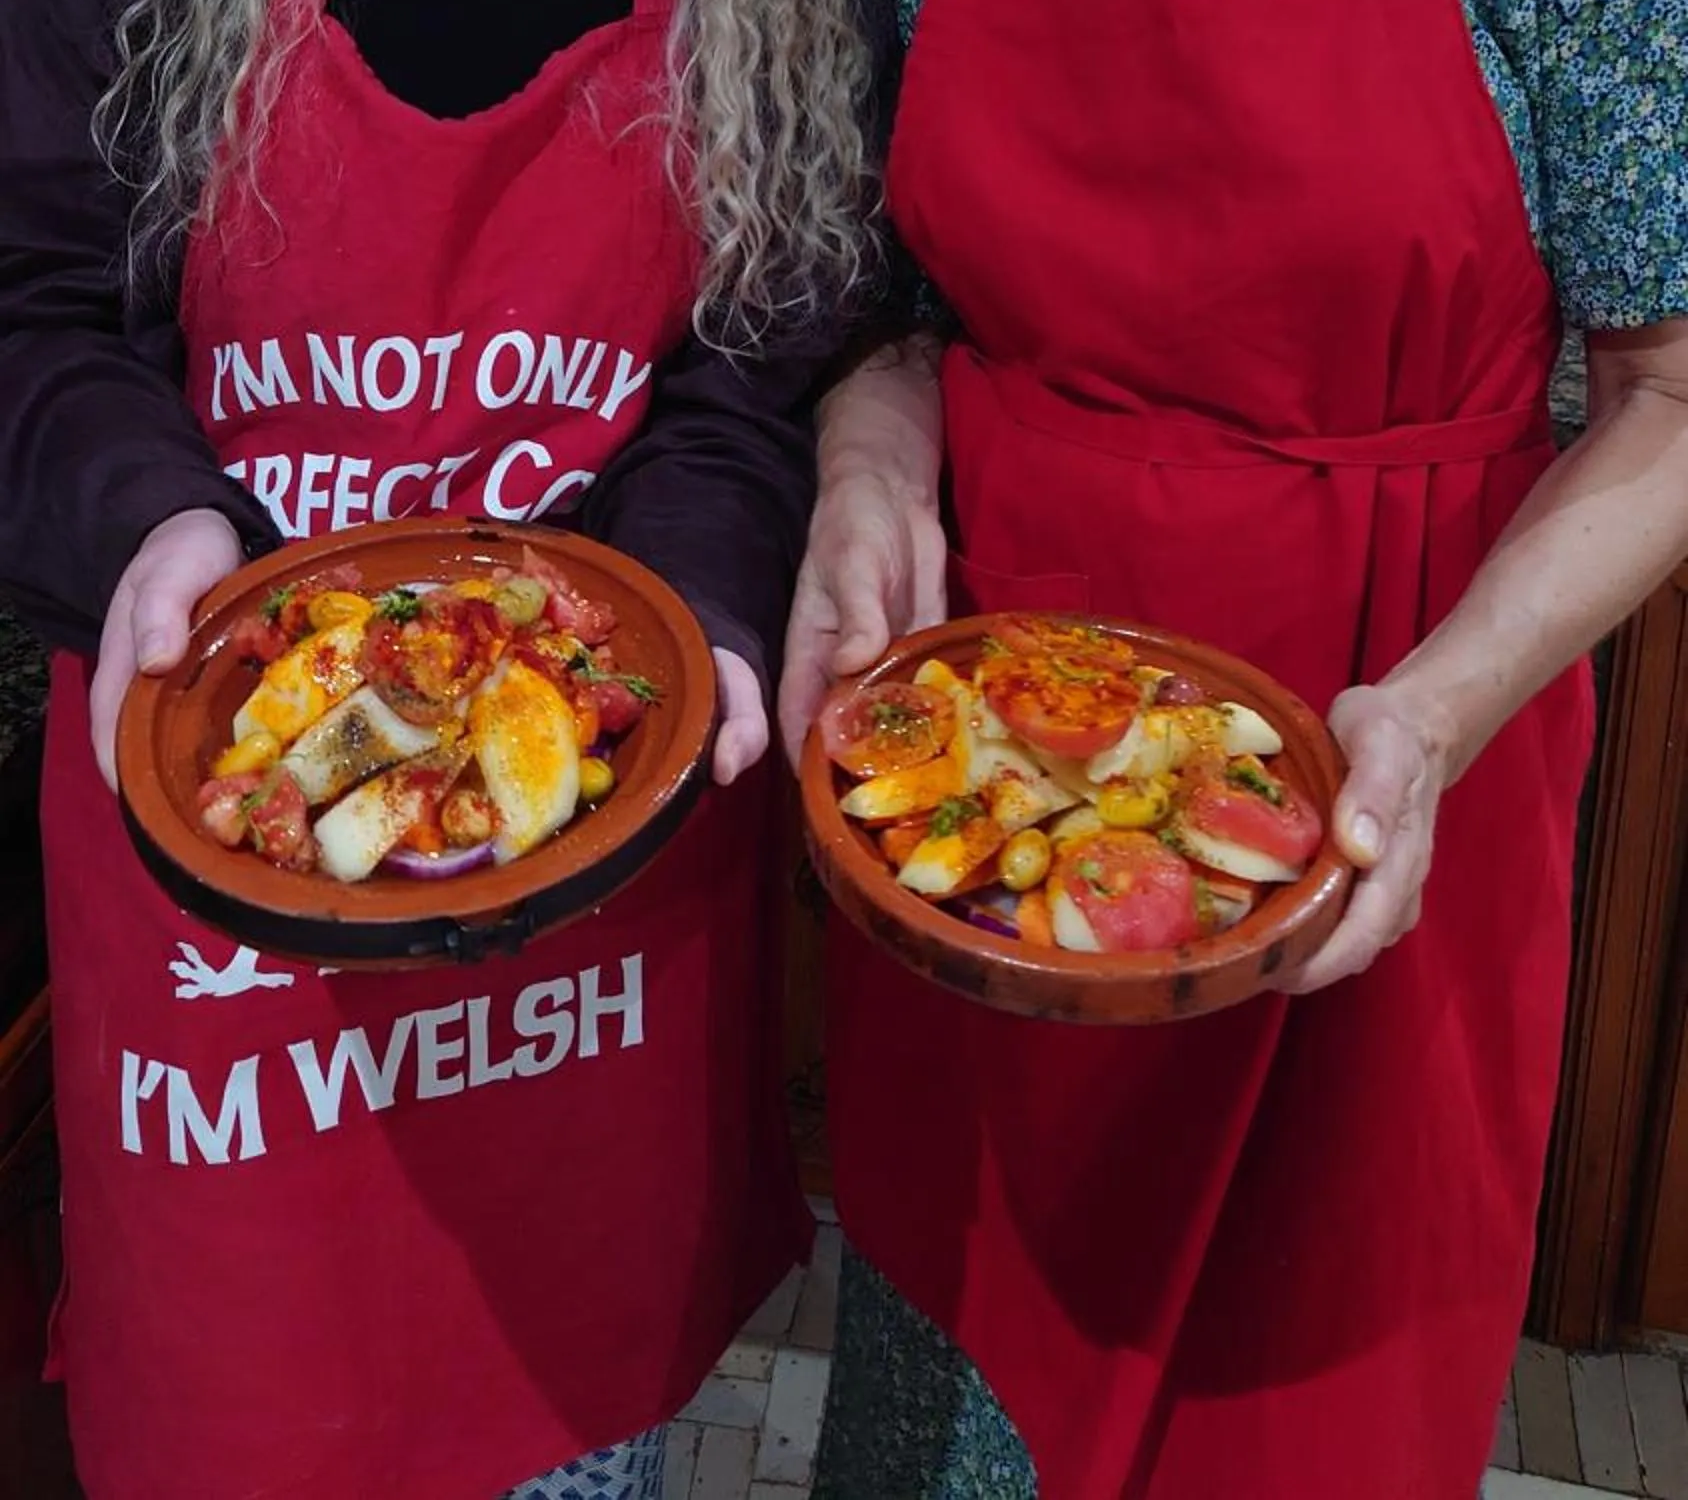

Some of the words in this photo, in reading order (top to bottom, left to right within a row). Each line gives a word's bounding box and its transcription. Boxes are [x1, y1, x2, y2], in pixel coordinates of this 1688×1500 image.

[212, 338, 300, 420] I'M
[306, 332, 463, 411] NOT
[476, 330, 651, 421] ONLY
[223, 449, 480, 538] RFECT
[122, 1050, 266, 1165] I'M
[287, 953, 643, 1132] WELSH
